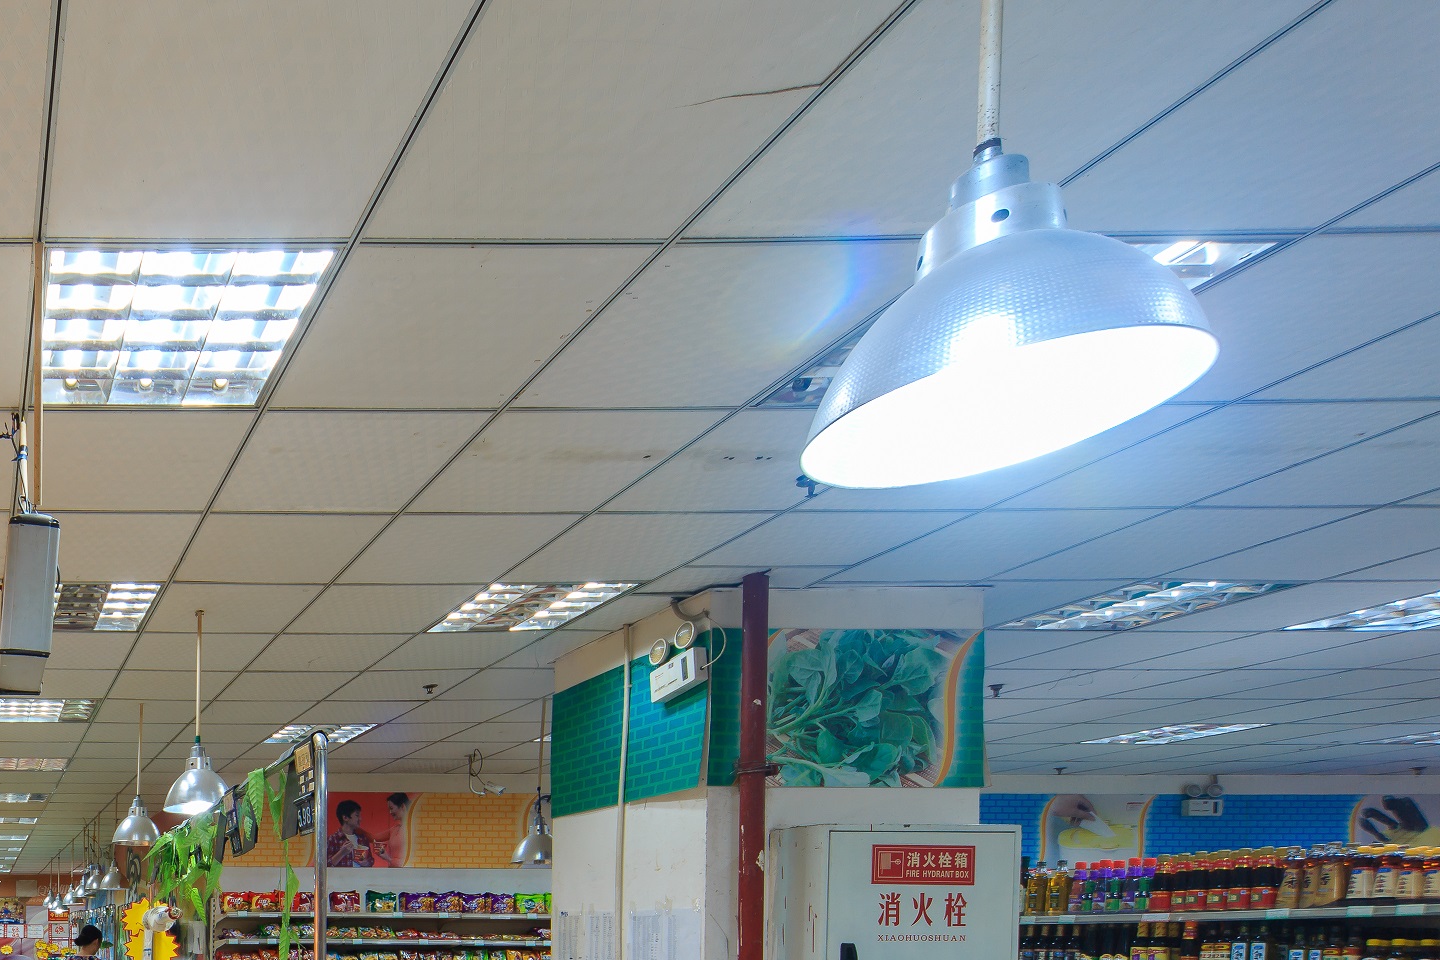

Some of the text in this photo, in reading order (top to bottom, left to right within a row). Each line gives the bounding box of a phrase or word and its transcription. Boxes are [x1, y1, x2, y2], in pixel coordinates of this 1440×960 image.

[906, 850, 969, 868] 消火栓箱
[906, 870, 969, 879] FIRE HYDRANT BOX
[877, 892, 968, 927] 消火栓
[877, 934, 967, 942] XIAOHUOSHUAN
